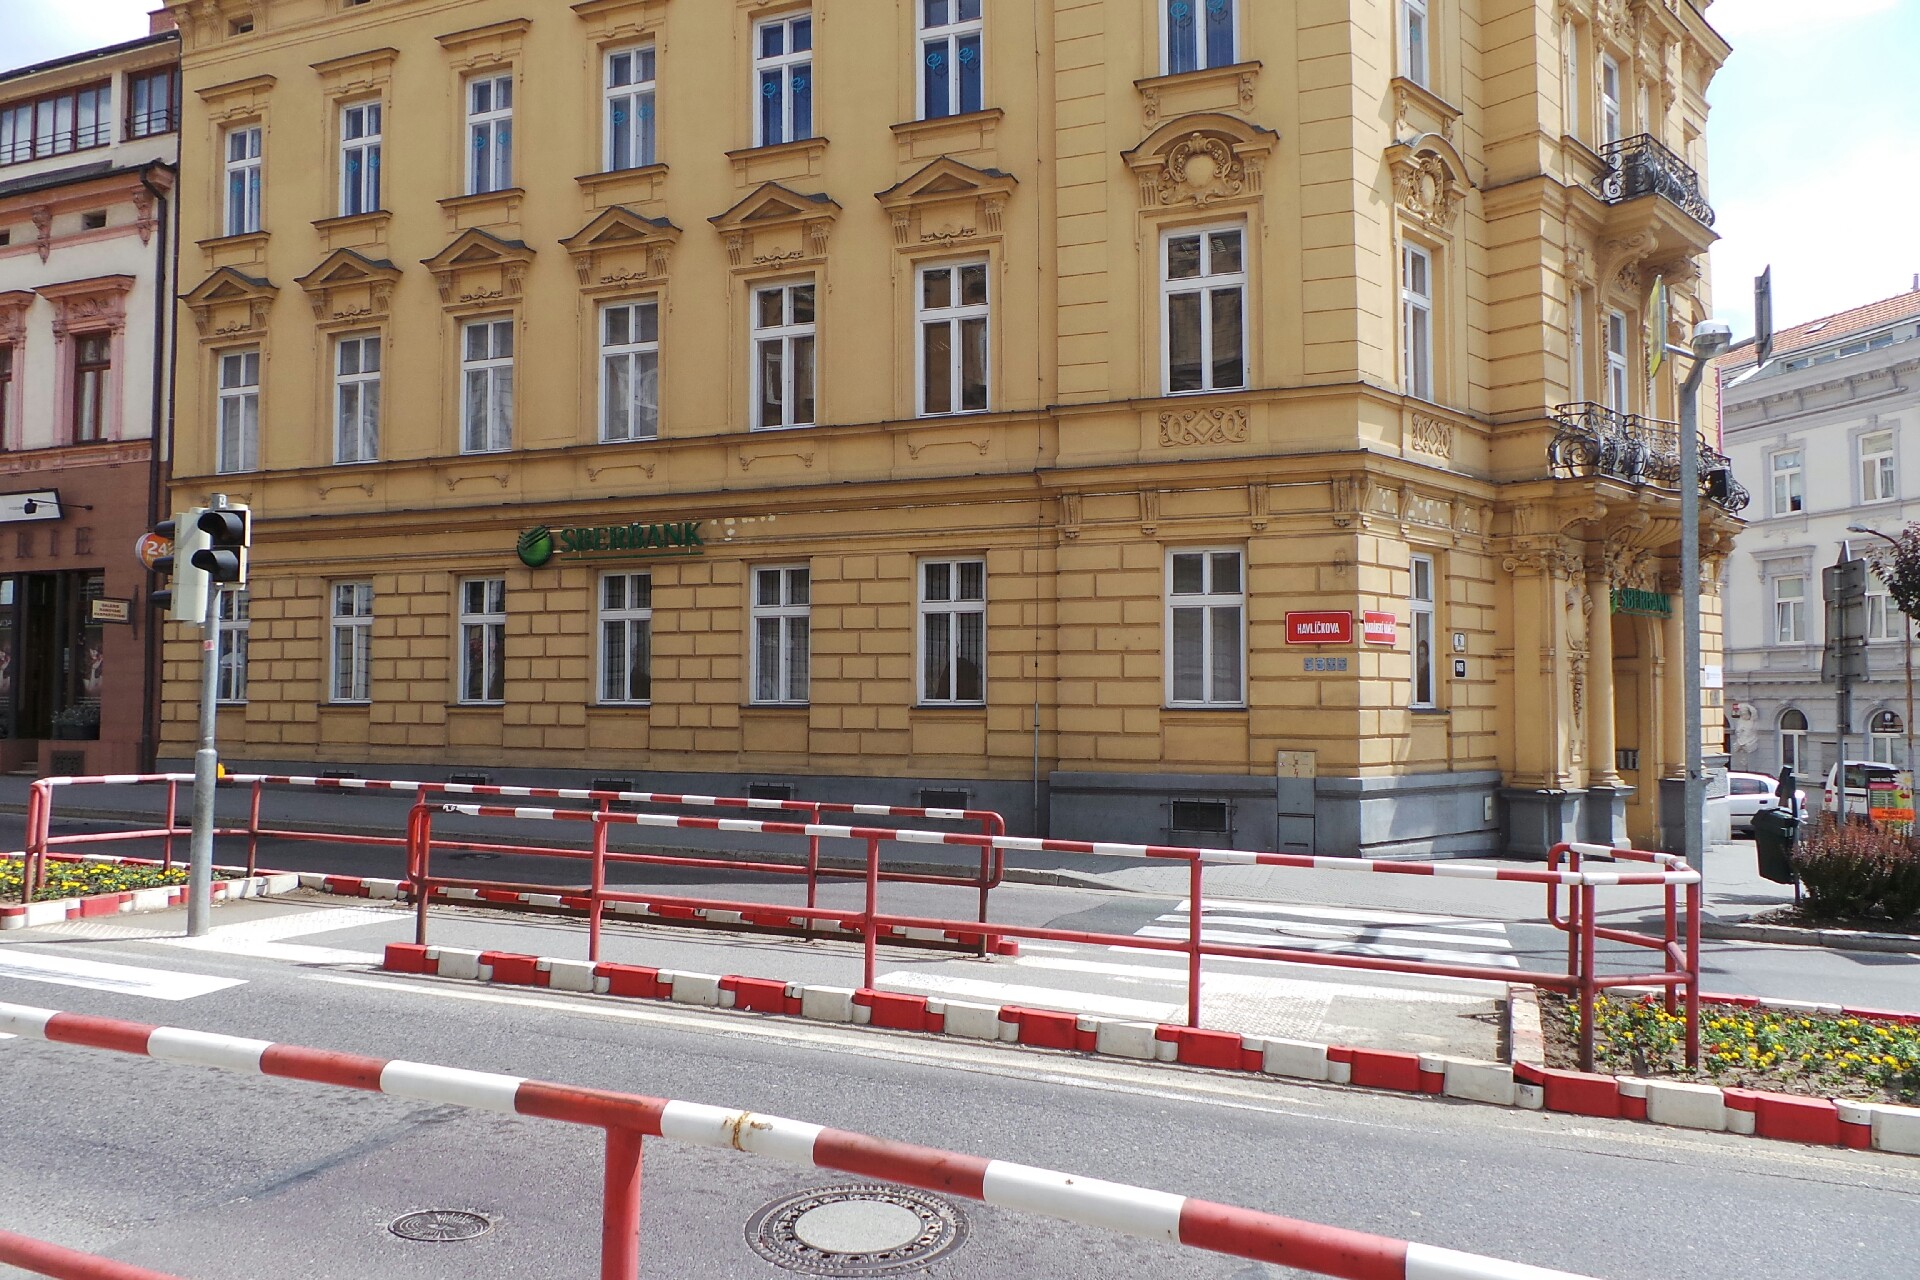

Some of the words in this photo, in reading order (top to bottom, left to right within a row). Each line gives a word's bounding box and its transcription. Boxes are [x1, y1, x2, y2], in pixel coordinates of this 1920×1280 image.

[560, 522, 704, 551] SBERBANK
[1621, 588, 1672, 613] SBERBANK
[1297, 621, 1340, 634] HAVLÍČKOVA
